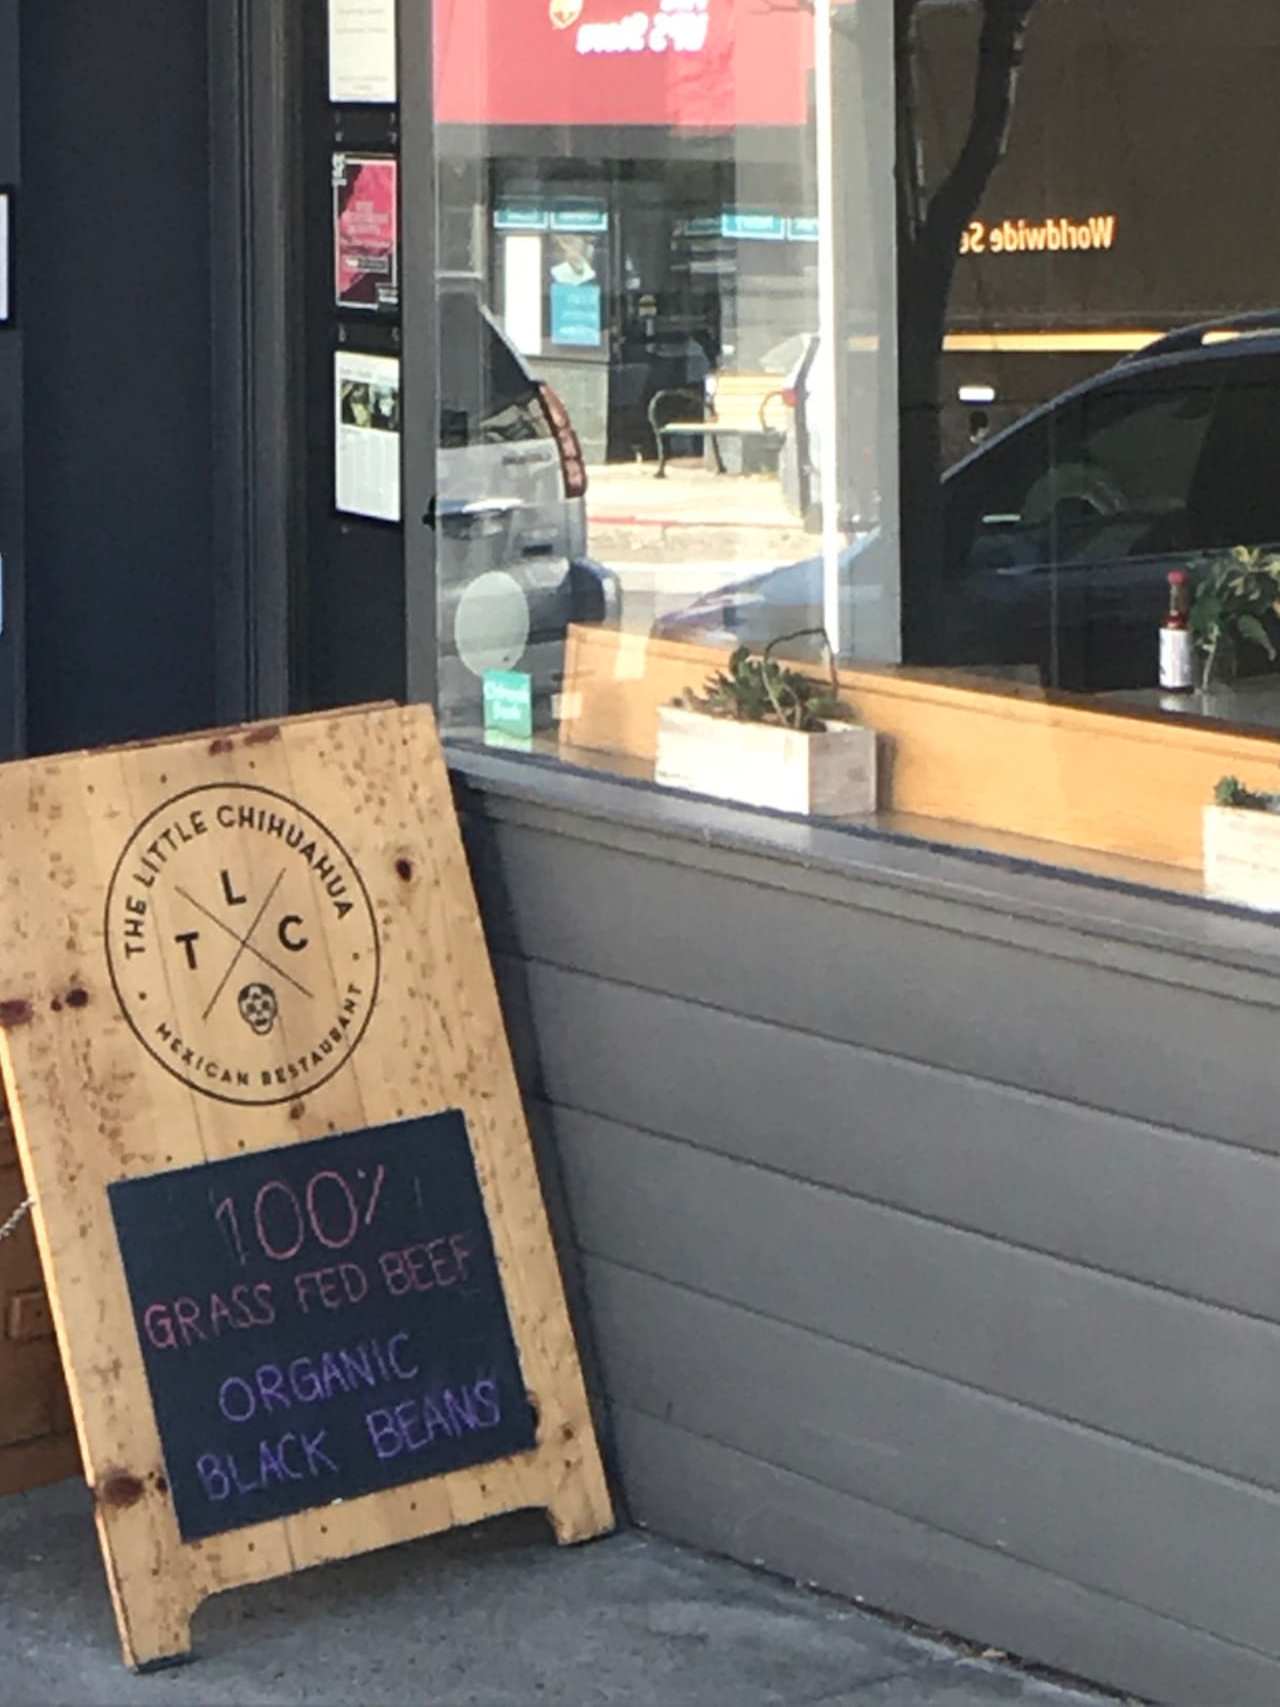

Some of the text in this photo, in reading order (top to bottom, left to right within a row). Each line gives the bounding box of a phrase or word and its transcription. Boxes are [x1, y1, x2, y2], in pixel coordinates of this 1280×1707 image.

[124, 805, 354, 960] THE LITTLE CHIHUAHUA
[220, 870, 248, 906] L
[174, 914, 309, 970] T C
[155, 982, 363, 1087] MEXICAN RESTAURANT
[215, 1164, 385, 1266] 100%
[143, 1230, 475, 1350] GRASS FED BEEF
[218, 1331, 420, 1424] ORGANIC
[196, 1376, 502, 1503] BLACK BEANS
